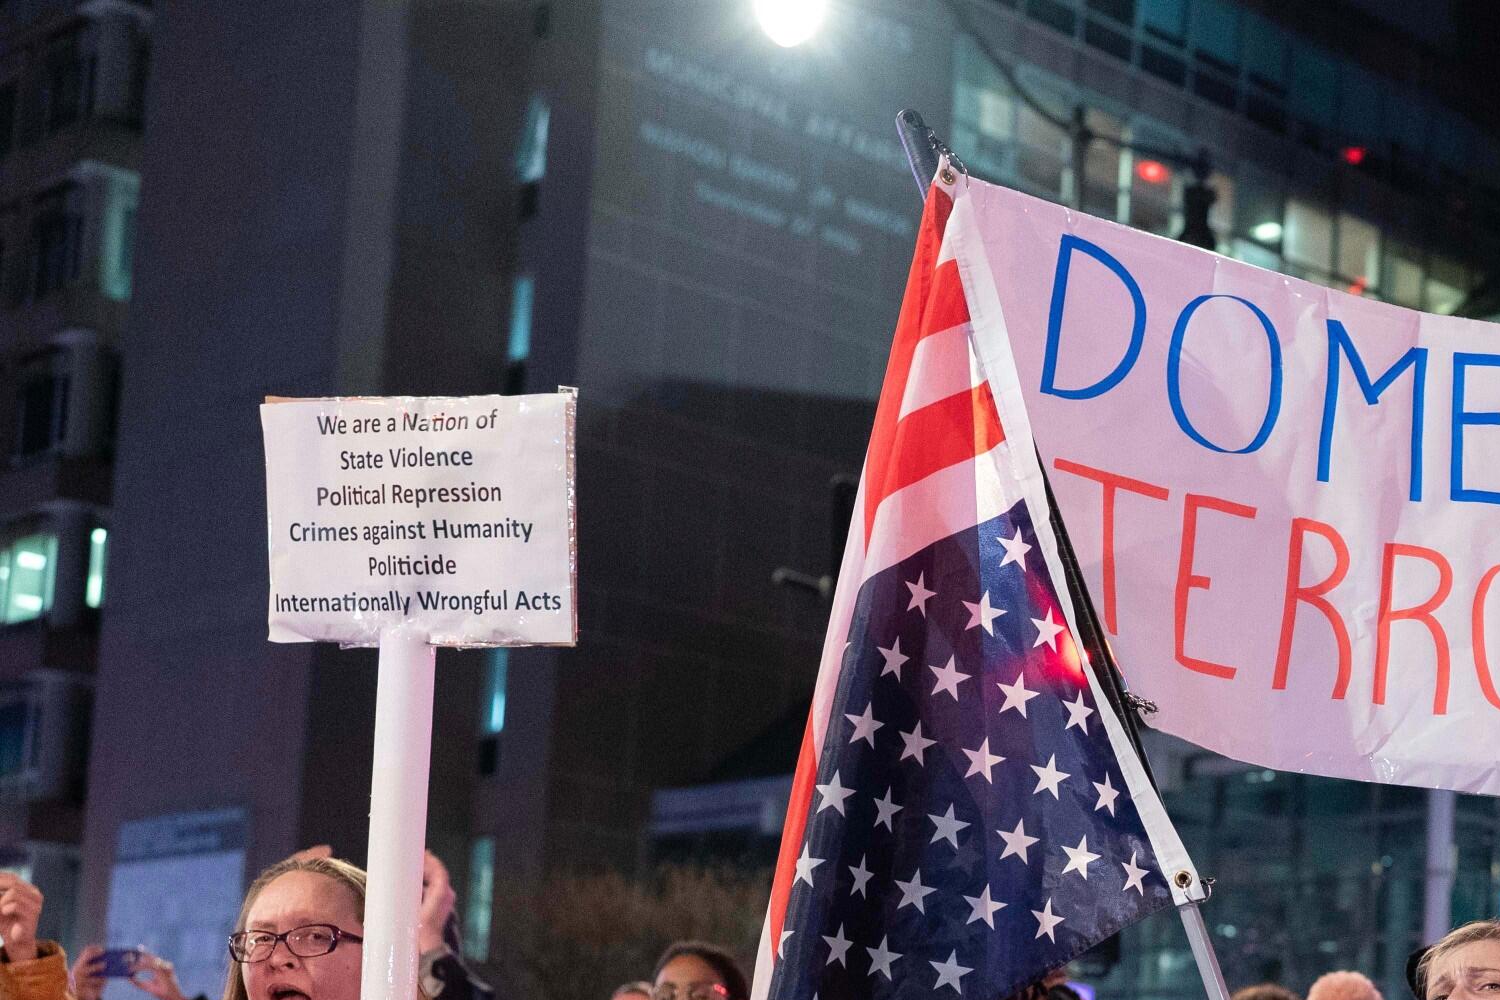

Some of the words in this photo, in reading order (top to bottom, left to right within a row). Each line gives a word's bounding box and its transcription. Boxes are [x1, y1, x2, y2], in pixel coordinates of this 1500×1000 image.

[317, 415, 347, 436] We
[352, 417, 381, 433] are
[386, 417, 397, 432] a
[402, 411, 469, 432] Nation
[476, 408, 499, 430] of
[340, 449, 384, 471] State
[389, 446, 474, 468] Violence
[316, 483, 386, 507] Political
[392, 481, 502, 508] Repression
[289, 522, 358, 543] Crimes
[363, 520, 426, 545] against
[432, 517, 533, 543] Humanity
[368, 555, 457, 577] Politicide
[275, 590, 411, 616] Internationally
[416, 589, 508, 615] Wrongful
[514, 590, 562, 611] Acts
